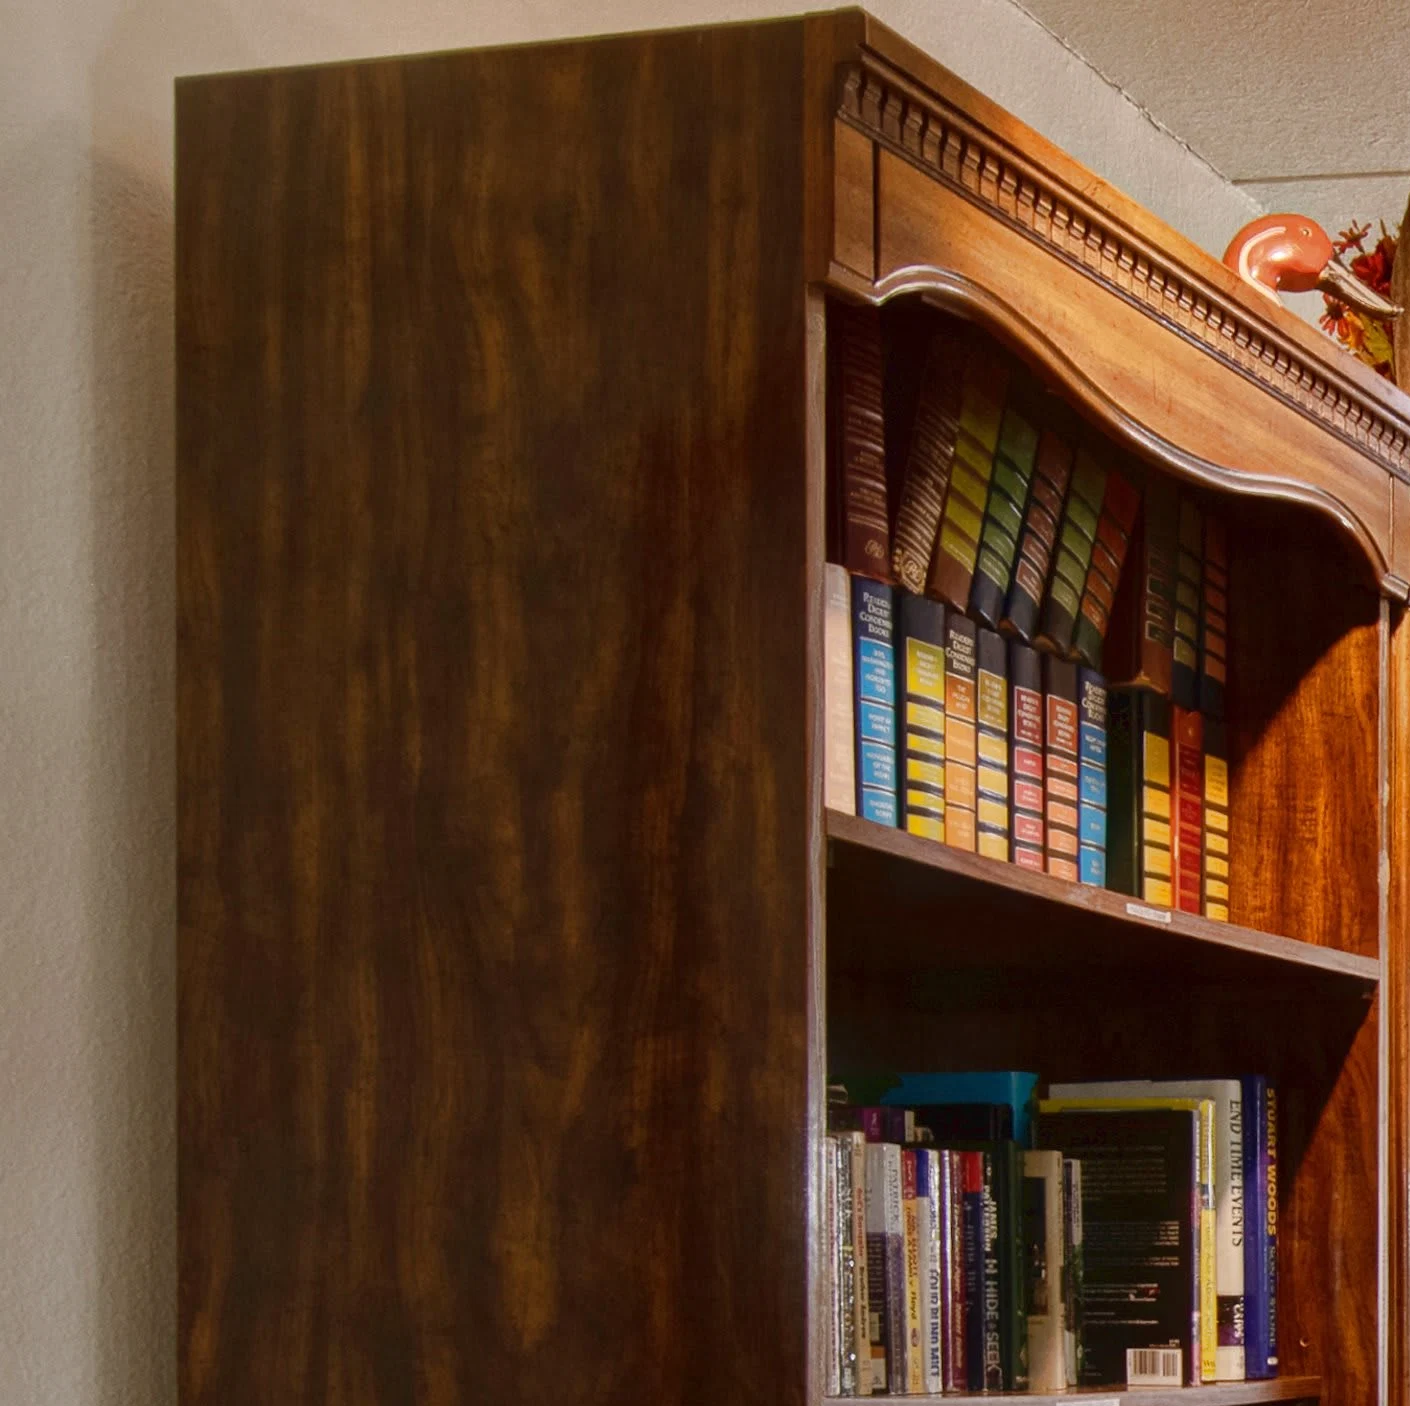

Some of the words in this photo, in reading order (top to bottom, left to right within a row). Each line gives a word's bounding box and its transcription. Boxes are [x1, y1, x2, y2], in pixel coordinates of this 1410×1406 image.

[1229, 1100, 1242, 1135] END
[1266, 1088, 1277, 1158] STUART
[1230, 1140, 1243, 1181] TIME
[1231, 1185, 1243, 1247] EVENTS
[1267, 1162, 1277, 1237] WOODS
[989, 1200, 998, 1240] JAMES
[909, 1291, 918, 1321] Floyd
[986, 1281, 1000, 1320] HIDE
[859, 1303, 867, 1339] Andrew
[986, 1331, 1000, 1372] SEEK
